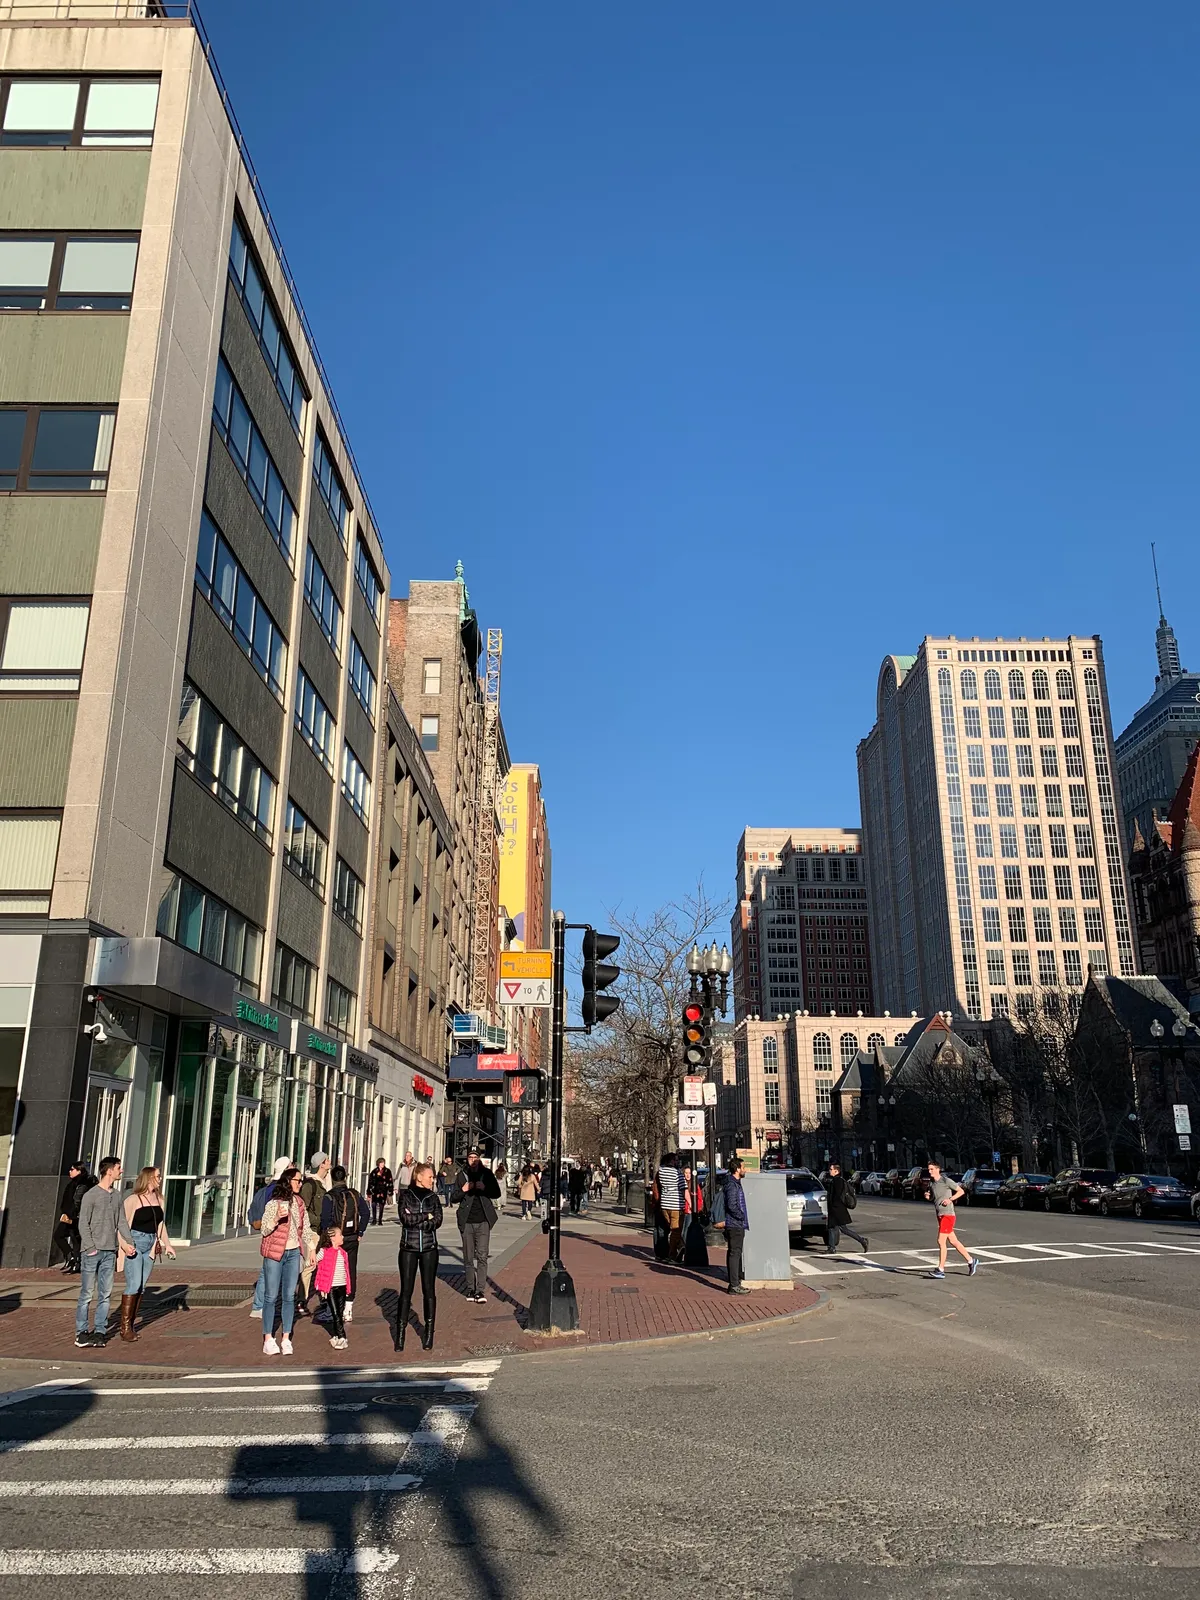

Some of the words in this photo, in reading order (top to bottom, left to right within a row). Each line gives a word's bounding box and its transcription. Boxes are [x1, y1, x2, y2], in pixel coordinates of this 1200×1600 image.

[518, 957, 547, 965] TURNING
[517, 966, 548, 974] VEHICLES
[523, 987, 533, 995] TO
[687, 1115, 696, 1124] T
